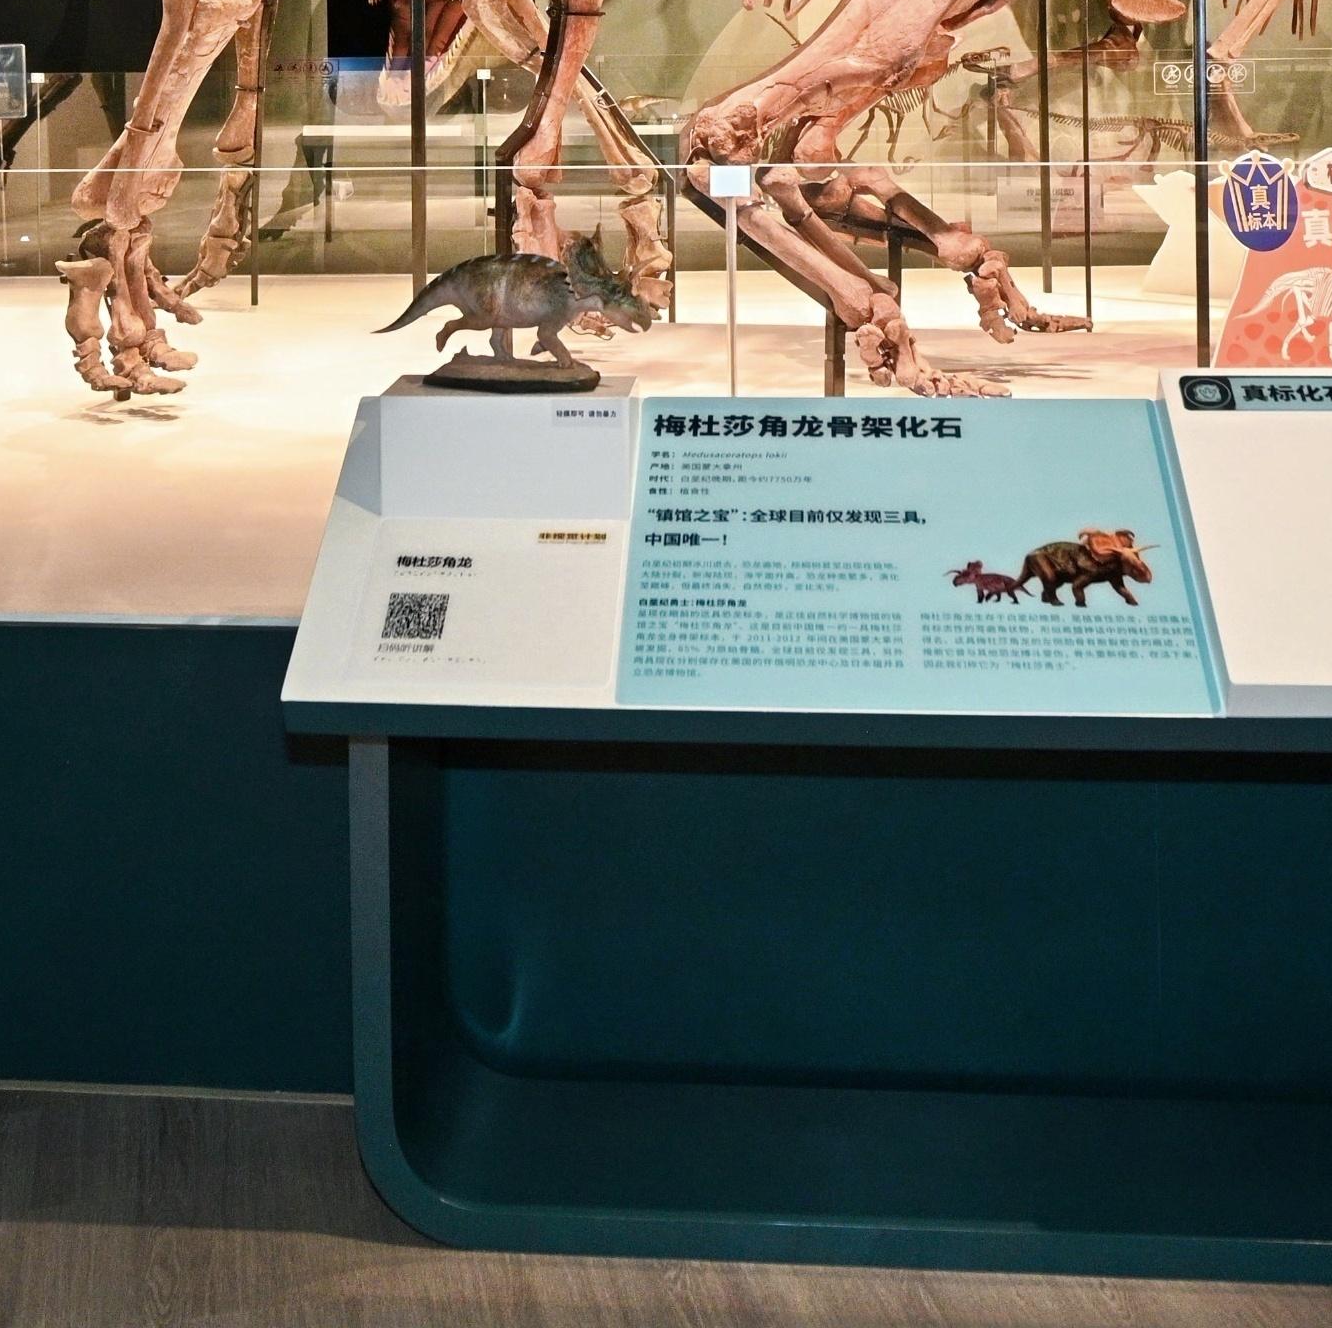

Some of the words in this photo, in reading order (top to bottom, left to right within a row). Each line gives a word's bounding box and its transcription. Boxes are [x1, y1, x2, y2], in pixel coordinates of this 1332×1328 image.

[1250, 184, 1271, 211] 真
[1247, 211, 1277, 231] 标本
[653, 414, 963, 439] 梅杜莎角龙骨架化石
[681, 451, 763, 460] Medusaceratops
[396, 556, 473, 569] 梅杜莎角龙
